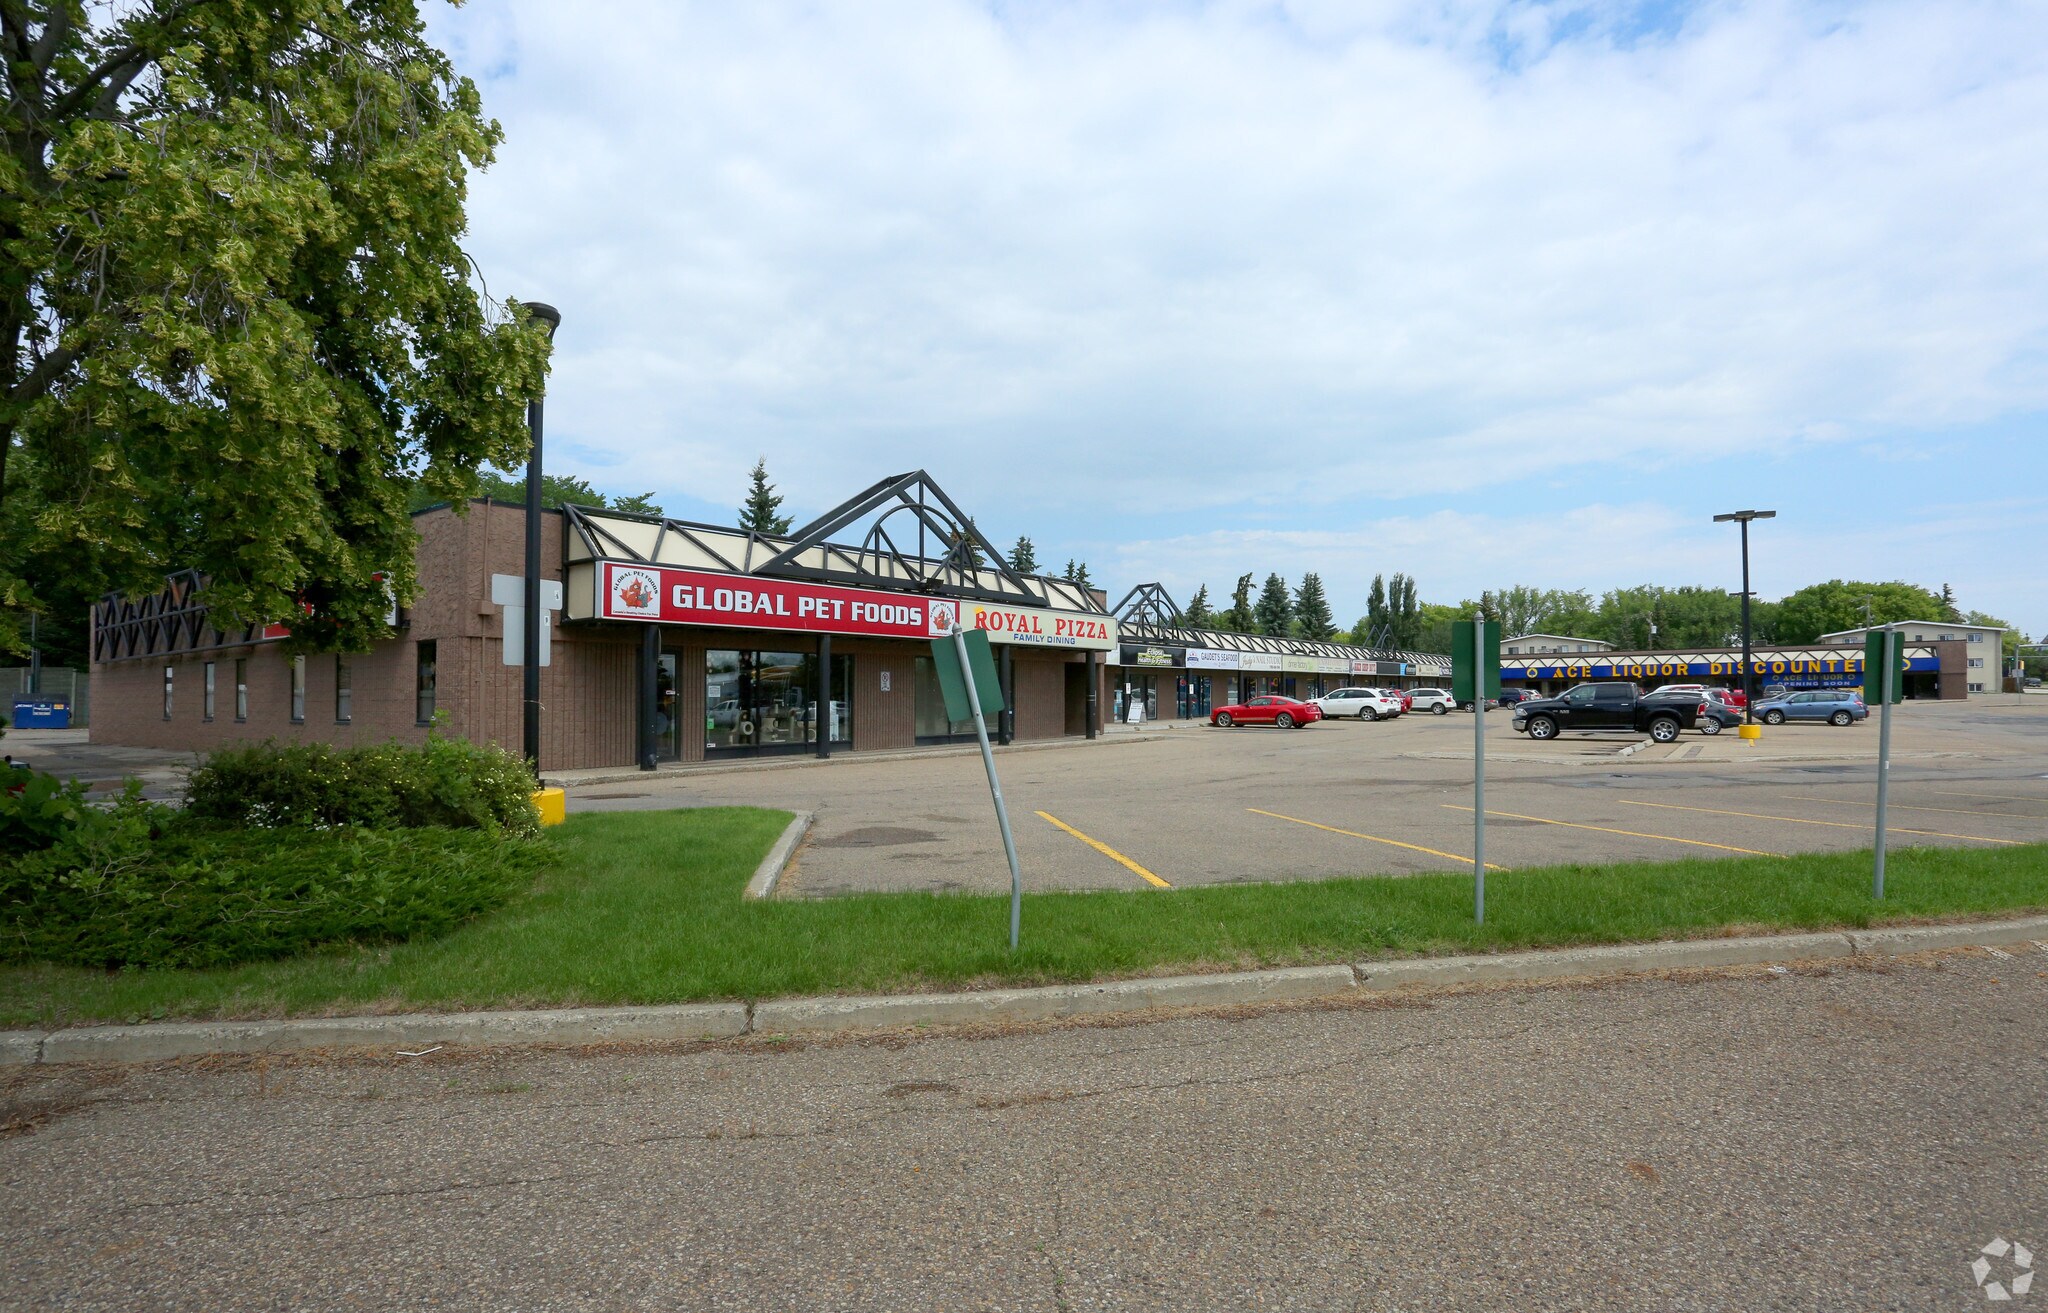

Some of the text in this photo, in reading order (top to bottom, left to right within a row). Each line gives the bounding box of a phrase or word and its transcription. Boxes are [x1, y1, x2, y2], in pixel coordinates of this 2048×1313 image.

[672, 584, 922, 626] GLOBAL PET FOODS
[974, 611, 1108, 640] ROYAL PIZZA
[1013, 633, 1076, 645] FAMILY DINING
[1201, 652, 1220, 661] GAUDET'S
[1221, 653, 1238, 662] SEAFOOD
[1553, 666, 1592, 678] ACE
[1612, 664, 1688, 678] LIQUOR
